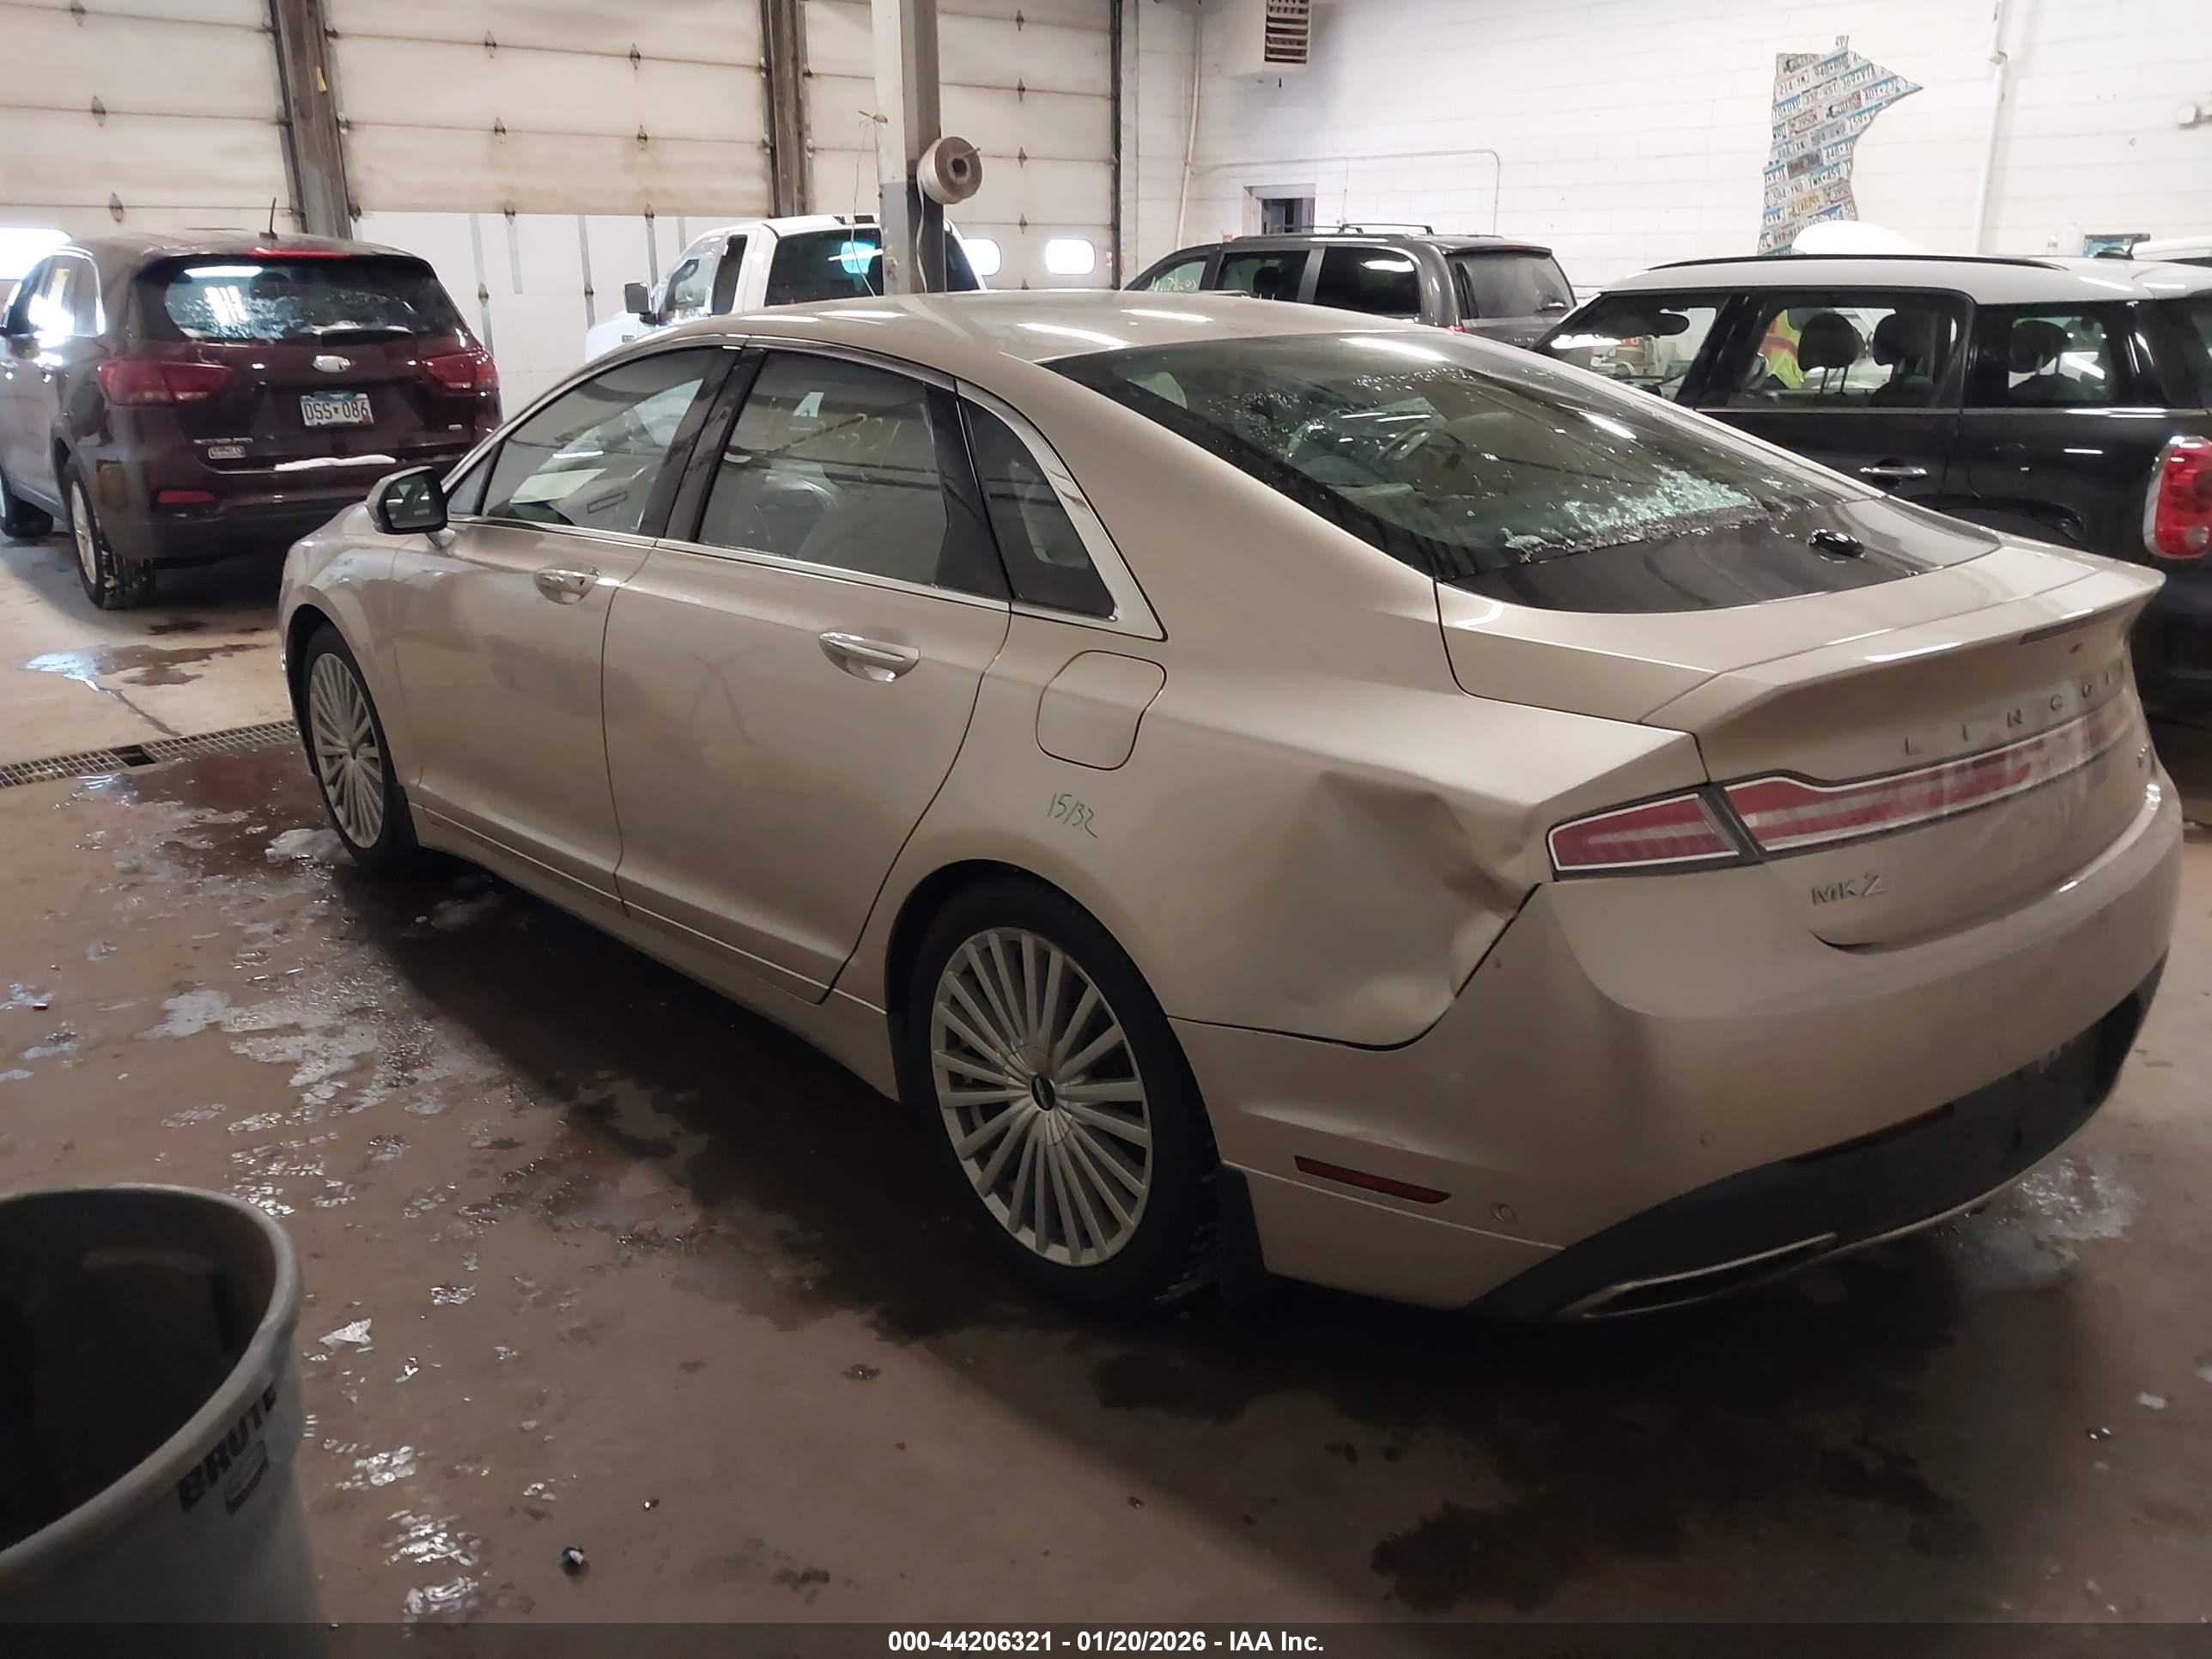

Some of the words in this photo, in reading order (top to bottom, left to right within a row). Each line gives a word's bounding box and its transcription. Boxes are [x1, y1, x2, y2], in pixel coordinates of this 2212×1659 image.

[342, 400, 369, 419] 086
[1046, 792, 1098, 839] 15/32
[1810, 872, 1887, 906] MKZ
